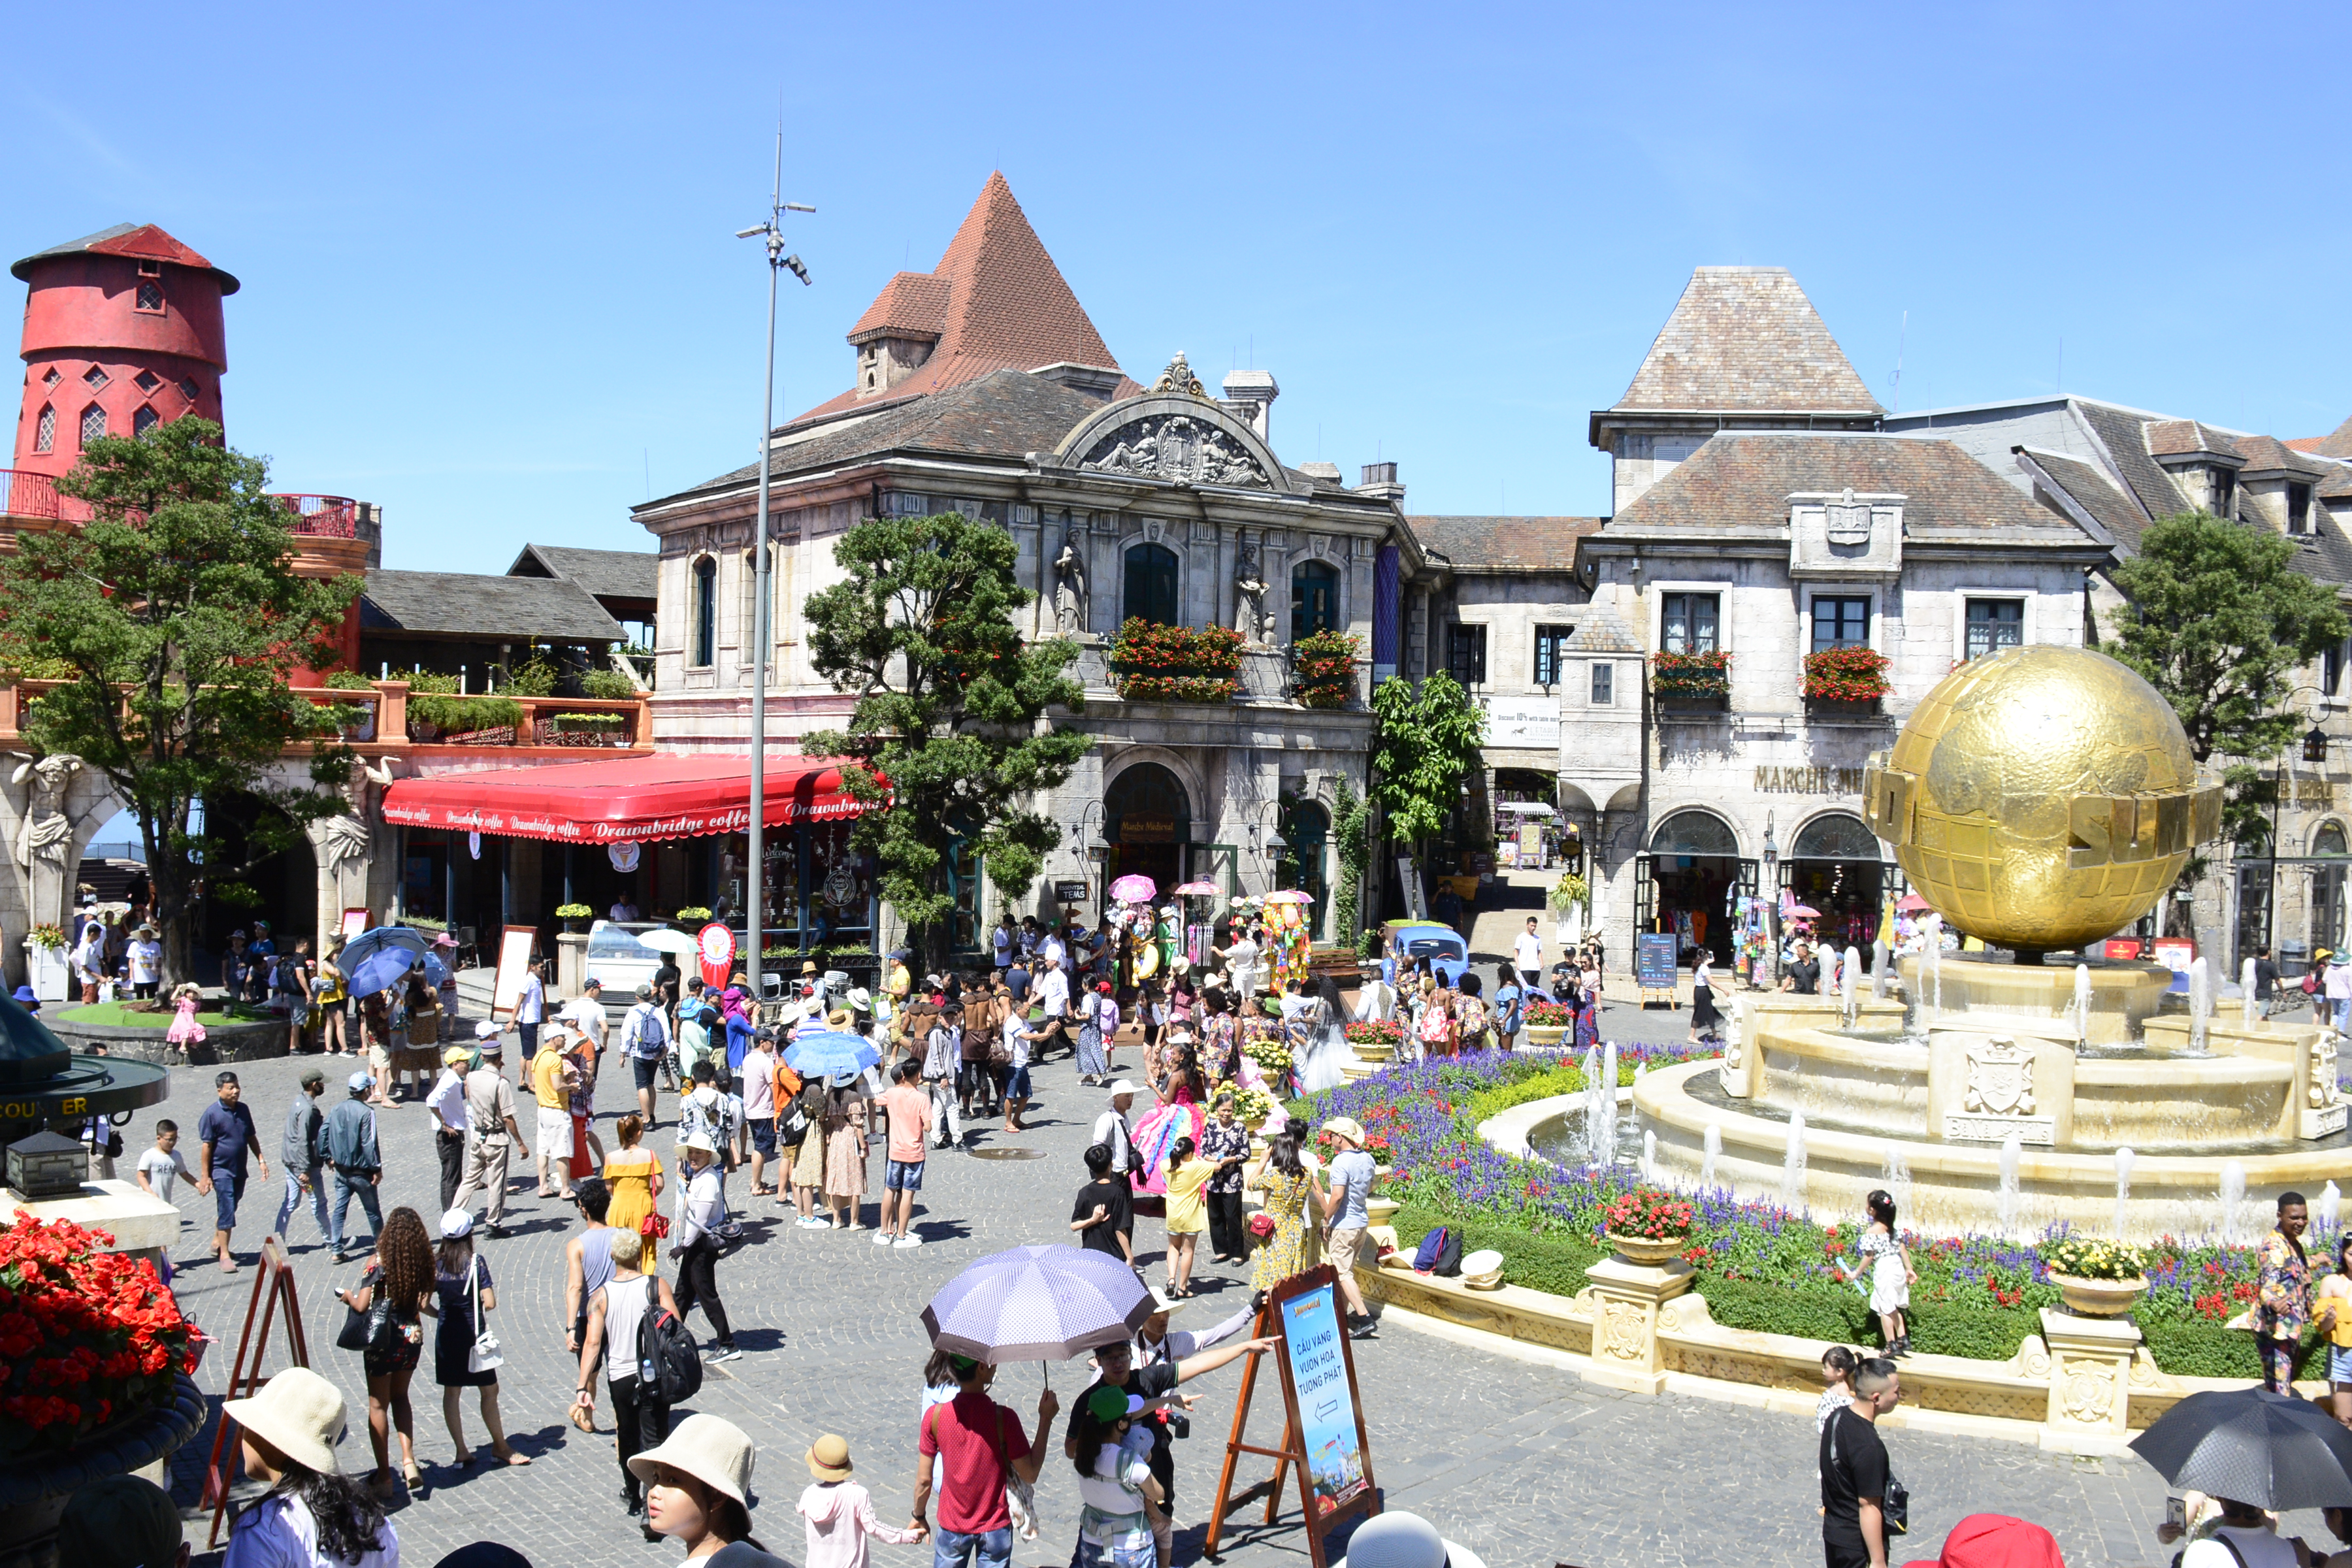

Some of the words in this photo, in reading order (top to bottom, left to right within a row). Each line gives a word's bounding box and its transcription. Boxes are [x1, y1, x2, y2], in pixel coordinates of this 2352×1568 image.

[414, 808, 431, 823] coffee
[485, 814, 503, 830] coffee
[593, 817, 704, 838] Drawnbridge
[709, 809, 751, 828] coffe
[511, 816, 555, 838] Drawnbridge
[556, 819, 580, 838] coffee
[0, 1098, 87, 1119] OUER
[1297, 1337, 1311, 1356] CẦU
[1311, 1330, 1331, 1348] VÀNG
[1320, 1348, 1335, 1365] HOA
[1324, 1365, 1342, 1384] PHẬT
